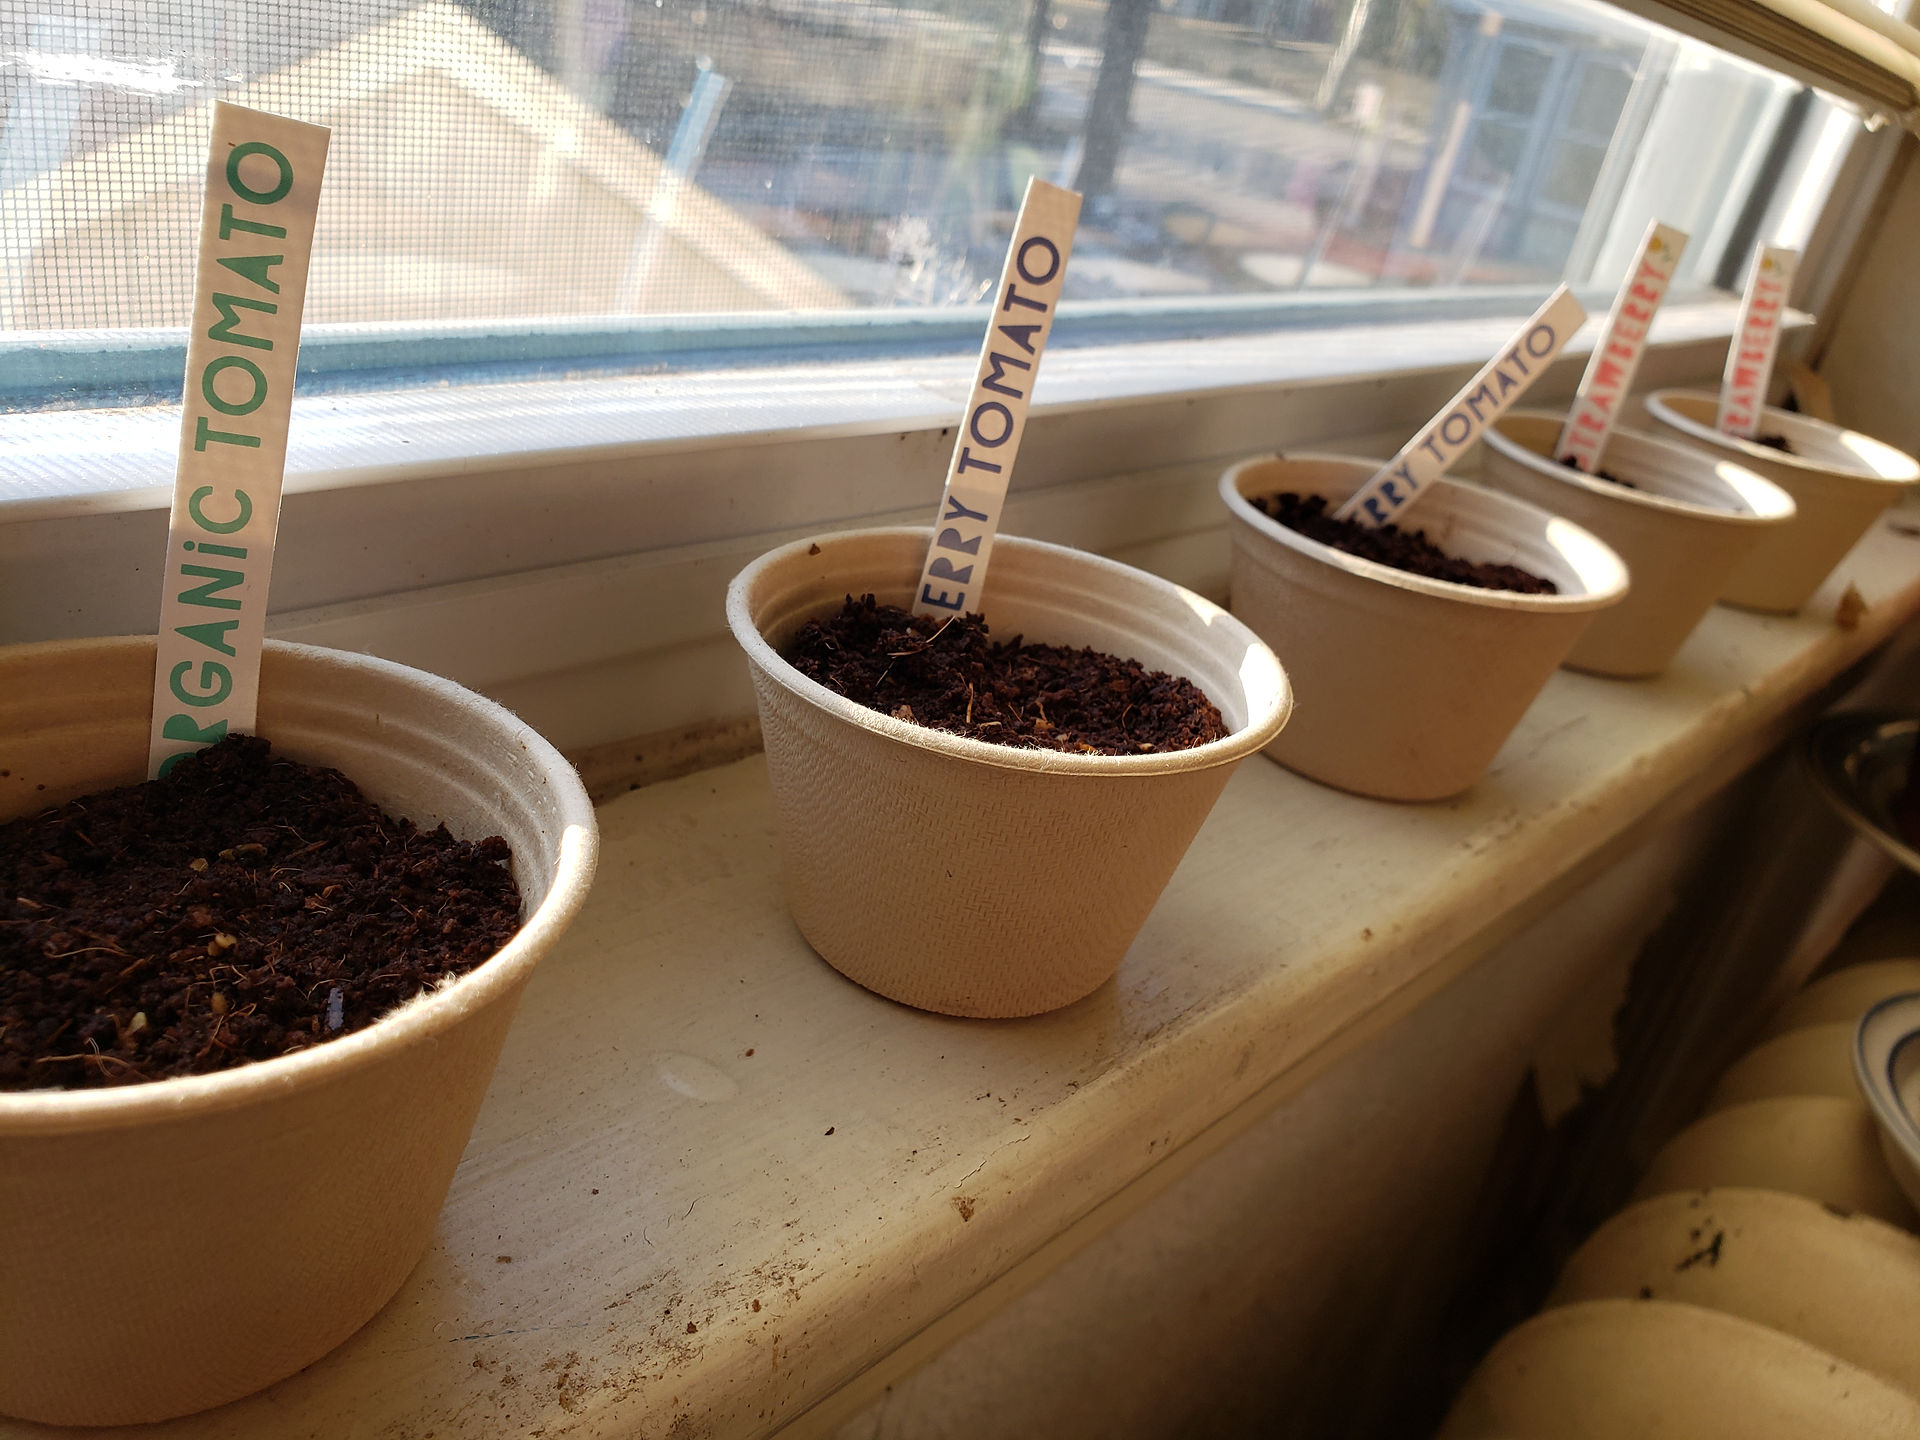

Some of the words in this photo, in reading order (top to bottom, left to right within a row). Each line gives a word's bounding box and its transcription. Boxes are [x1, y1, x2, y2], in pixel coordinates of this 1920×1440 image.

[194, 141, 293, 452] TOMATO
[920, 494, 989, 611] ERRY
[957, 236, 1061, 475] TOMATO
[1348, 461, 1419, 524] RRY
[1421, 324, 1556, 464] TOMATO
[1722, 279, 1783, 438] RAWBERRY
[157, 485, 253, 780] RGANiC
